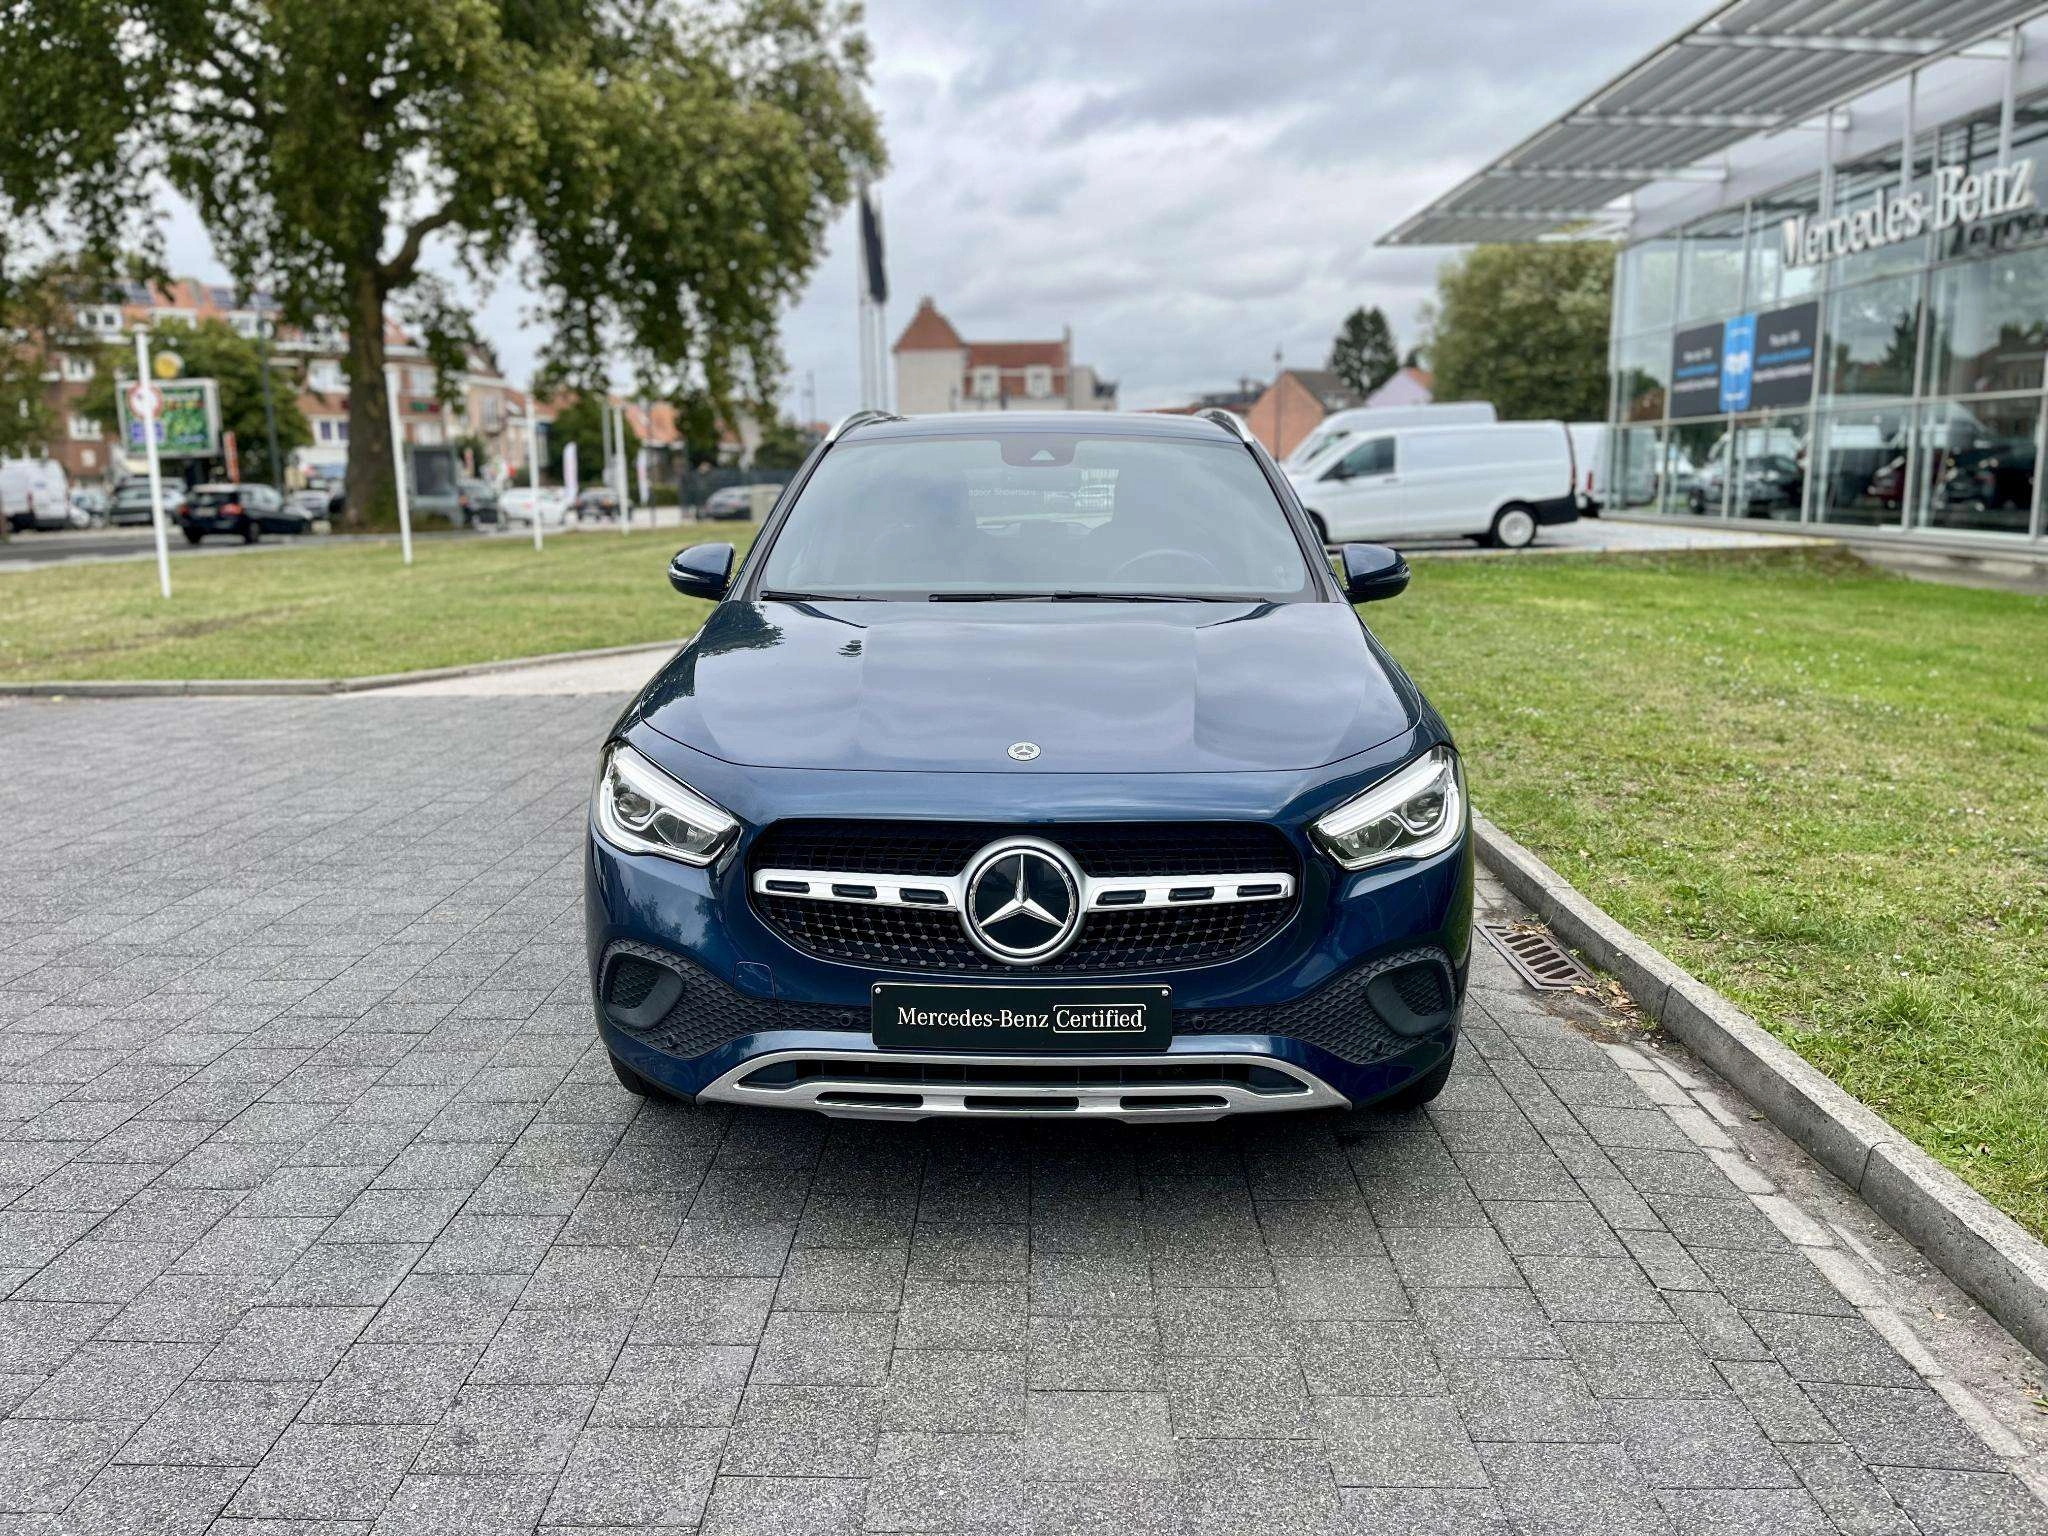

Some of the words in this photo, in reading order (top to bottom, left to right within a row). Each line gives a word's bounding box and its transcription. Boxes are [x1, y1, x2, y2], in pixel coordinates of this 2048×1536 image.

[1782, 158, 2037, 266] Mercedes-Benz
[897, 1006, 1049, 1028] Mercedes-Benz
[1056, 1009, 1143, 1028] Certified
